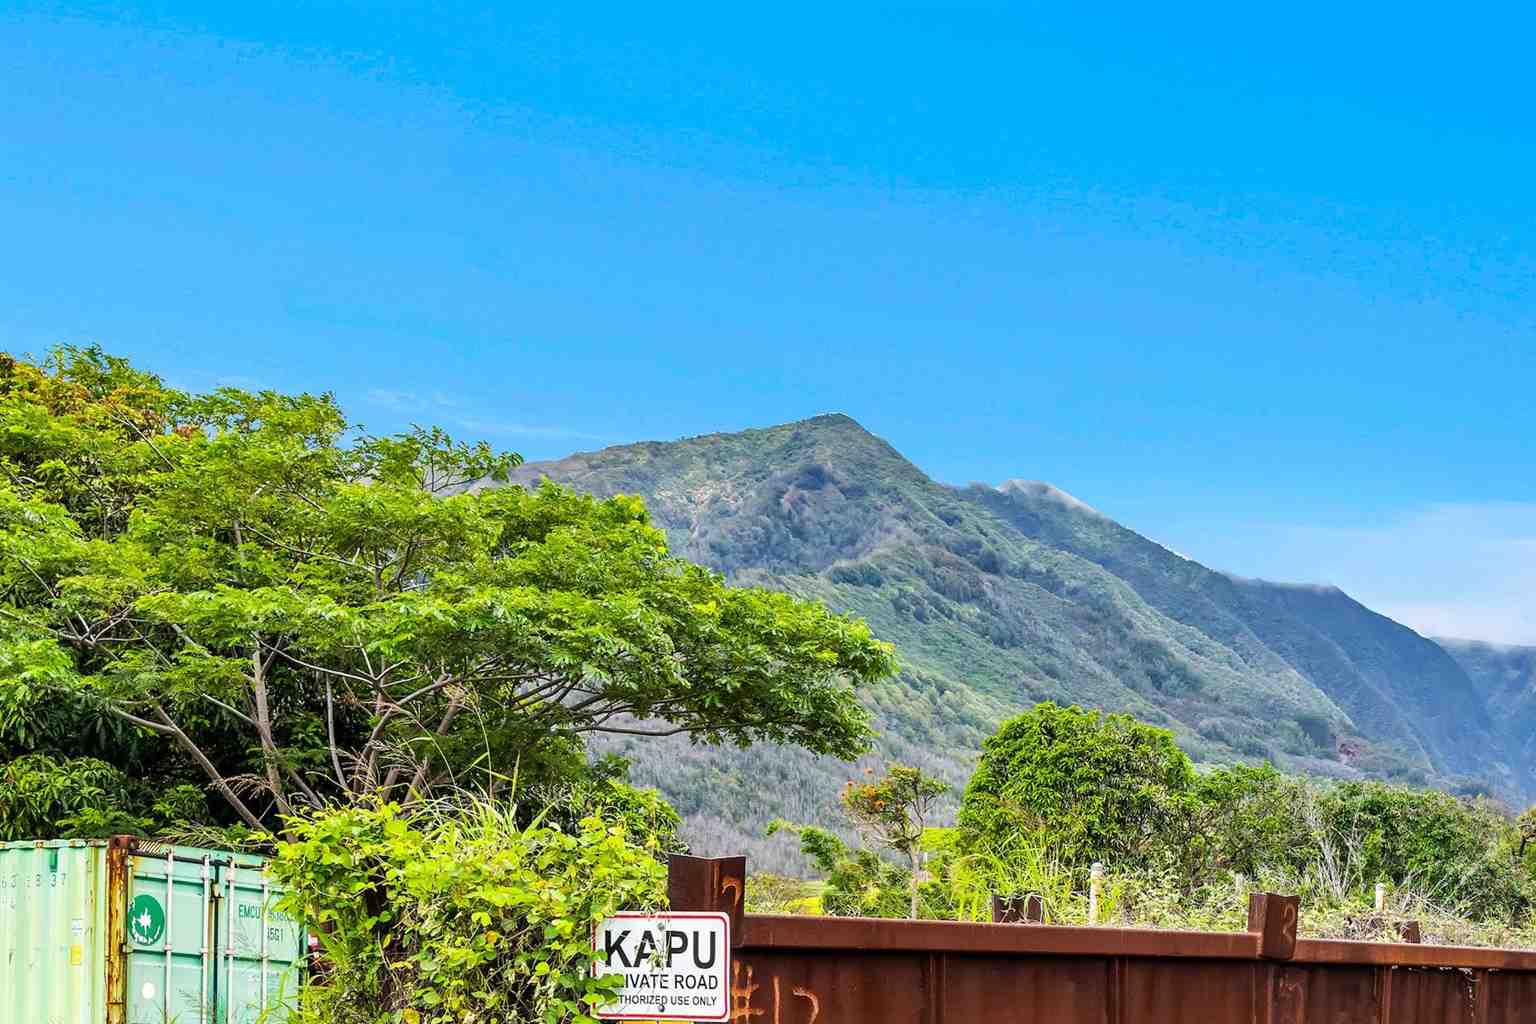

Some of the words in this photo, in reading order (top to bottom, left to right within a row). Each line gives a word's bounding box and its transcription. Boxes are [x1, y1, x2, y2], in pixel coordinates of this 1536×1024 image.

[605, 930, 716, 969] KAPU
[625, 974, 669, 989] IVATE
[674, 974, 719, 990] ROAD
[618, 994, 668, 1005] THORIZED
[670, 996, 690, 1006] USE
[692, 996, 717, 1006] ONLY
